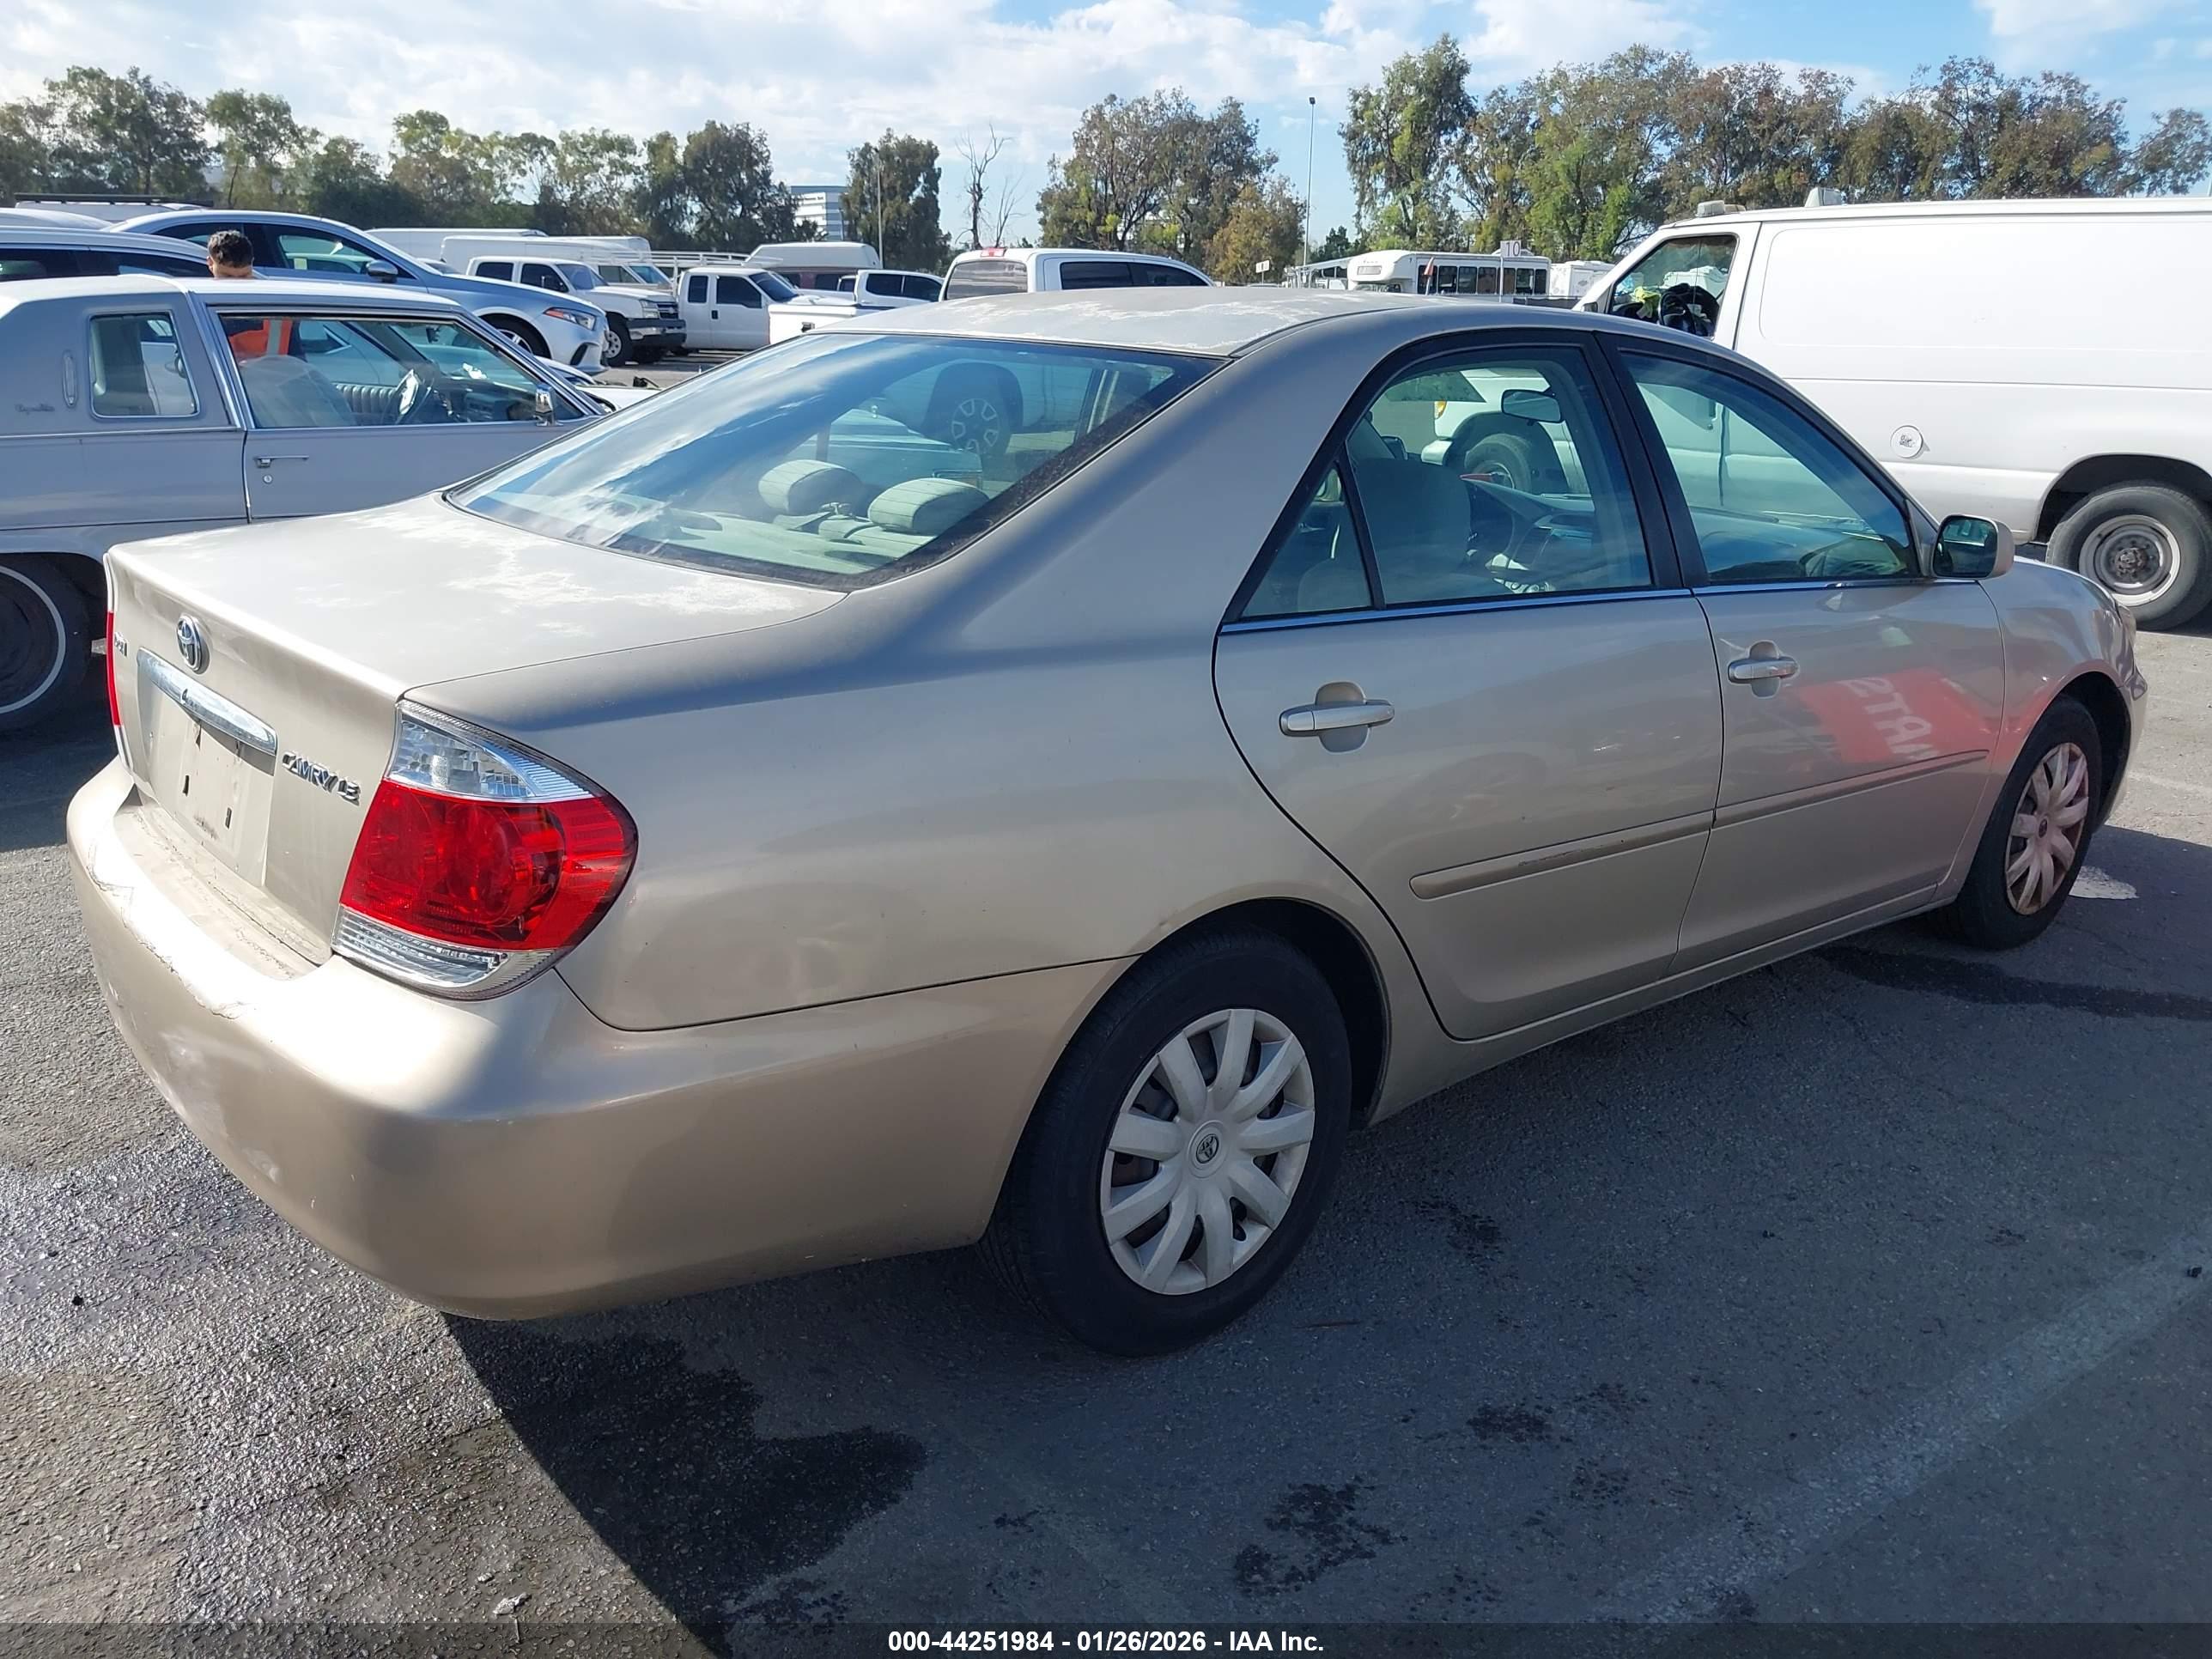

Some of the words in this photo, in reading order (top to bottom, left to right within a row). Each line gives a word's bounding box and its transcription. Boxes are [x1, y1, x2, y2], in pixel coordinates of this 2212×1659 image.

[1506, 240, 1521, 256] 10
[282, 750, 338, 795] CAMRY
[337, 777, 362, 807] LE
